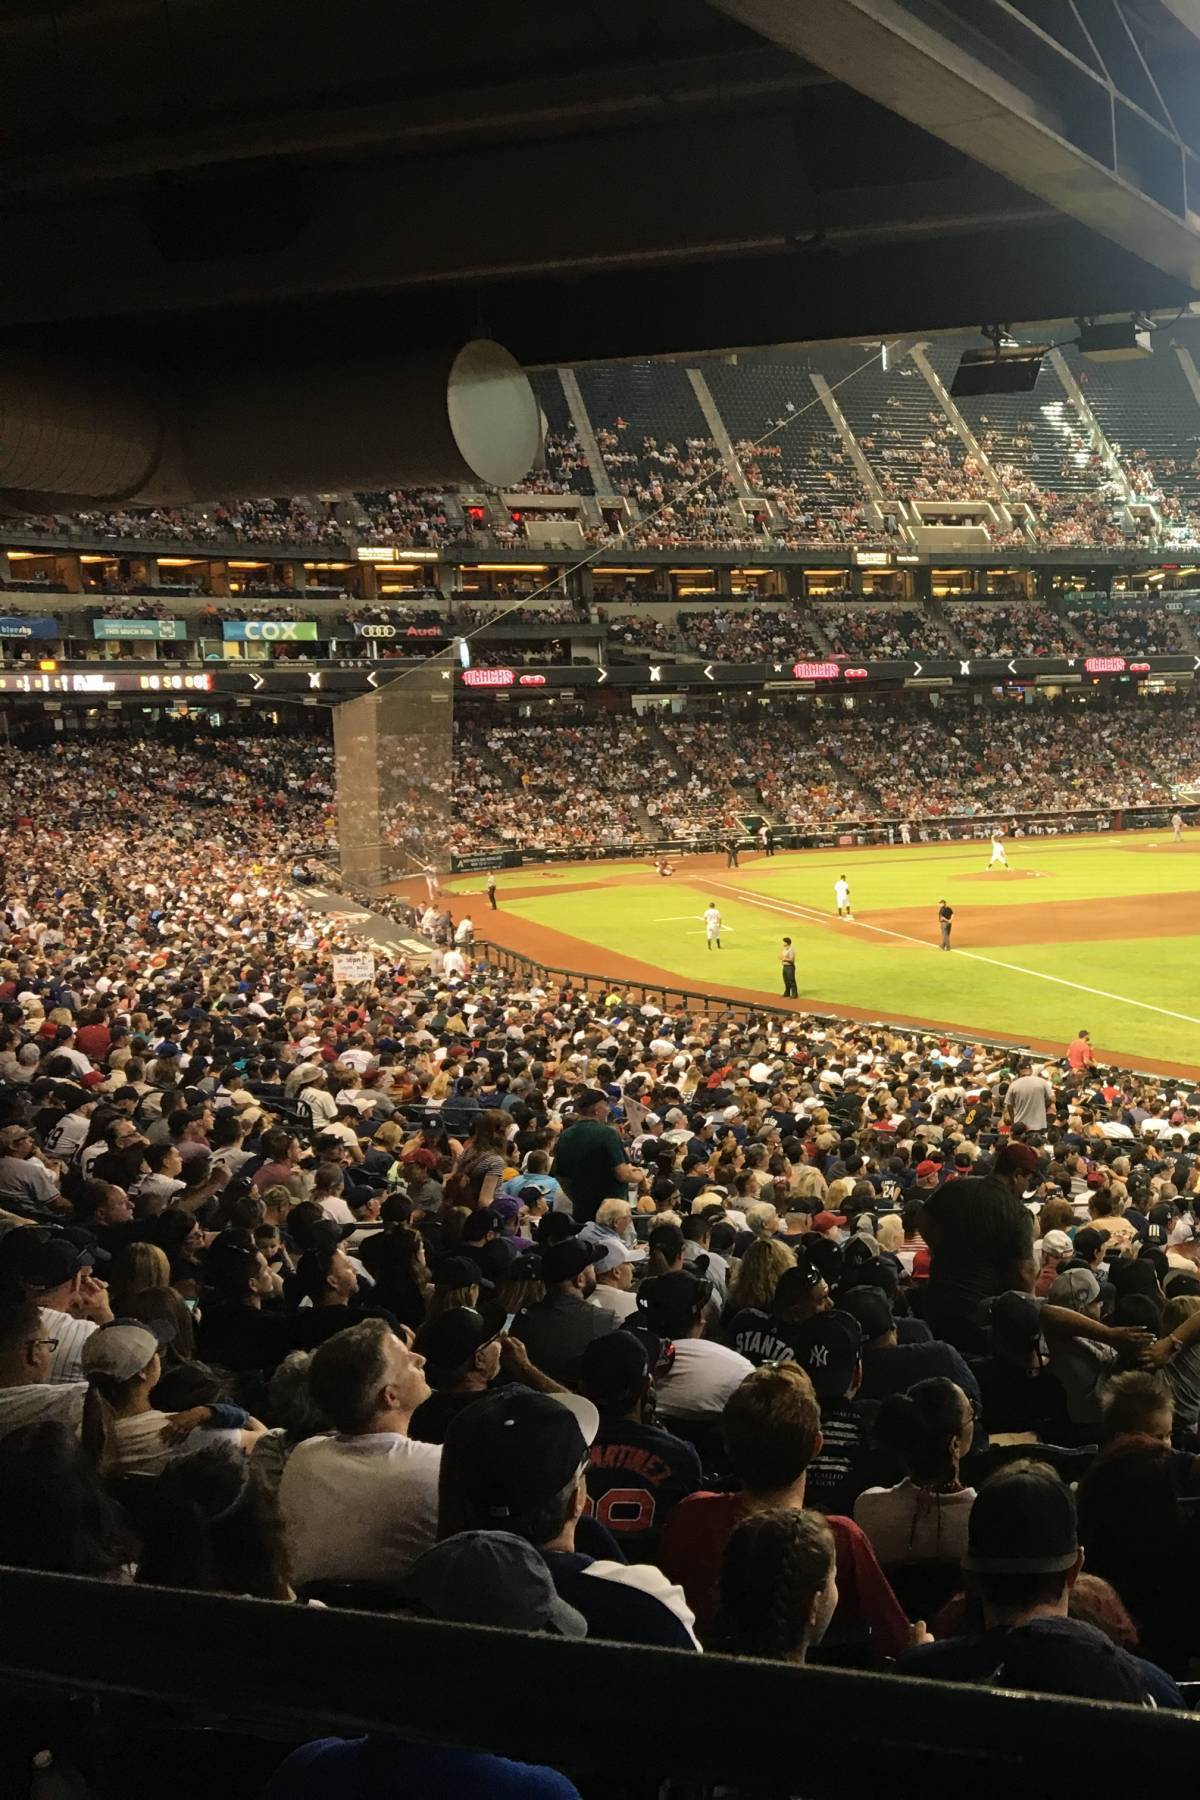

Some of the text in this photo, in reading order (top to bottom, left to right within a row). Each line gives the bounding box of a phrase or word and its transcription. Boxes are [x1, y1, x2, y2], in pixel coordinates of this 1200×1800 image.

[244, 622, 297, 640] COX
[407, 625, 441, 637] Audi
[736, 1330, 796, 1362] STANTO
[809, 1343, 830, 1368] NY
[590, 1443, 673, 1488] ARTINEZ
